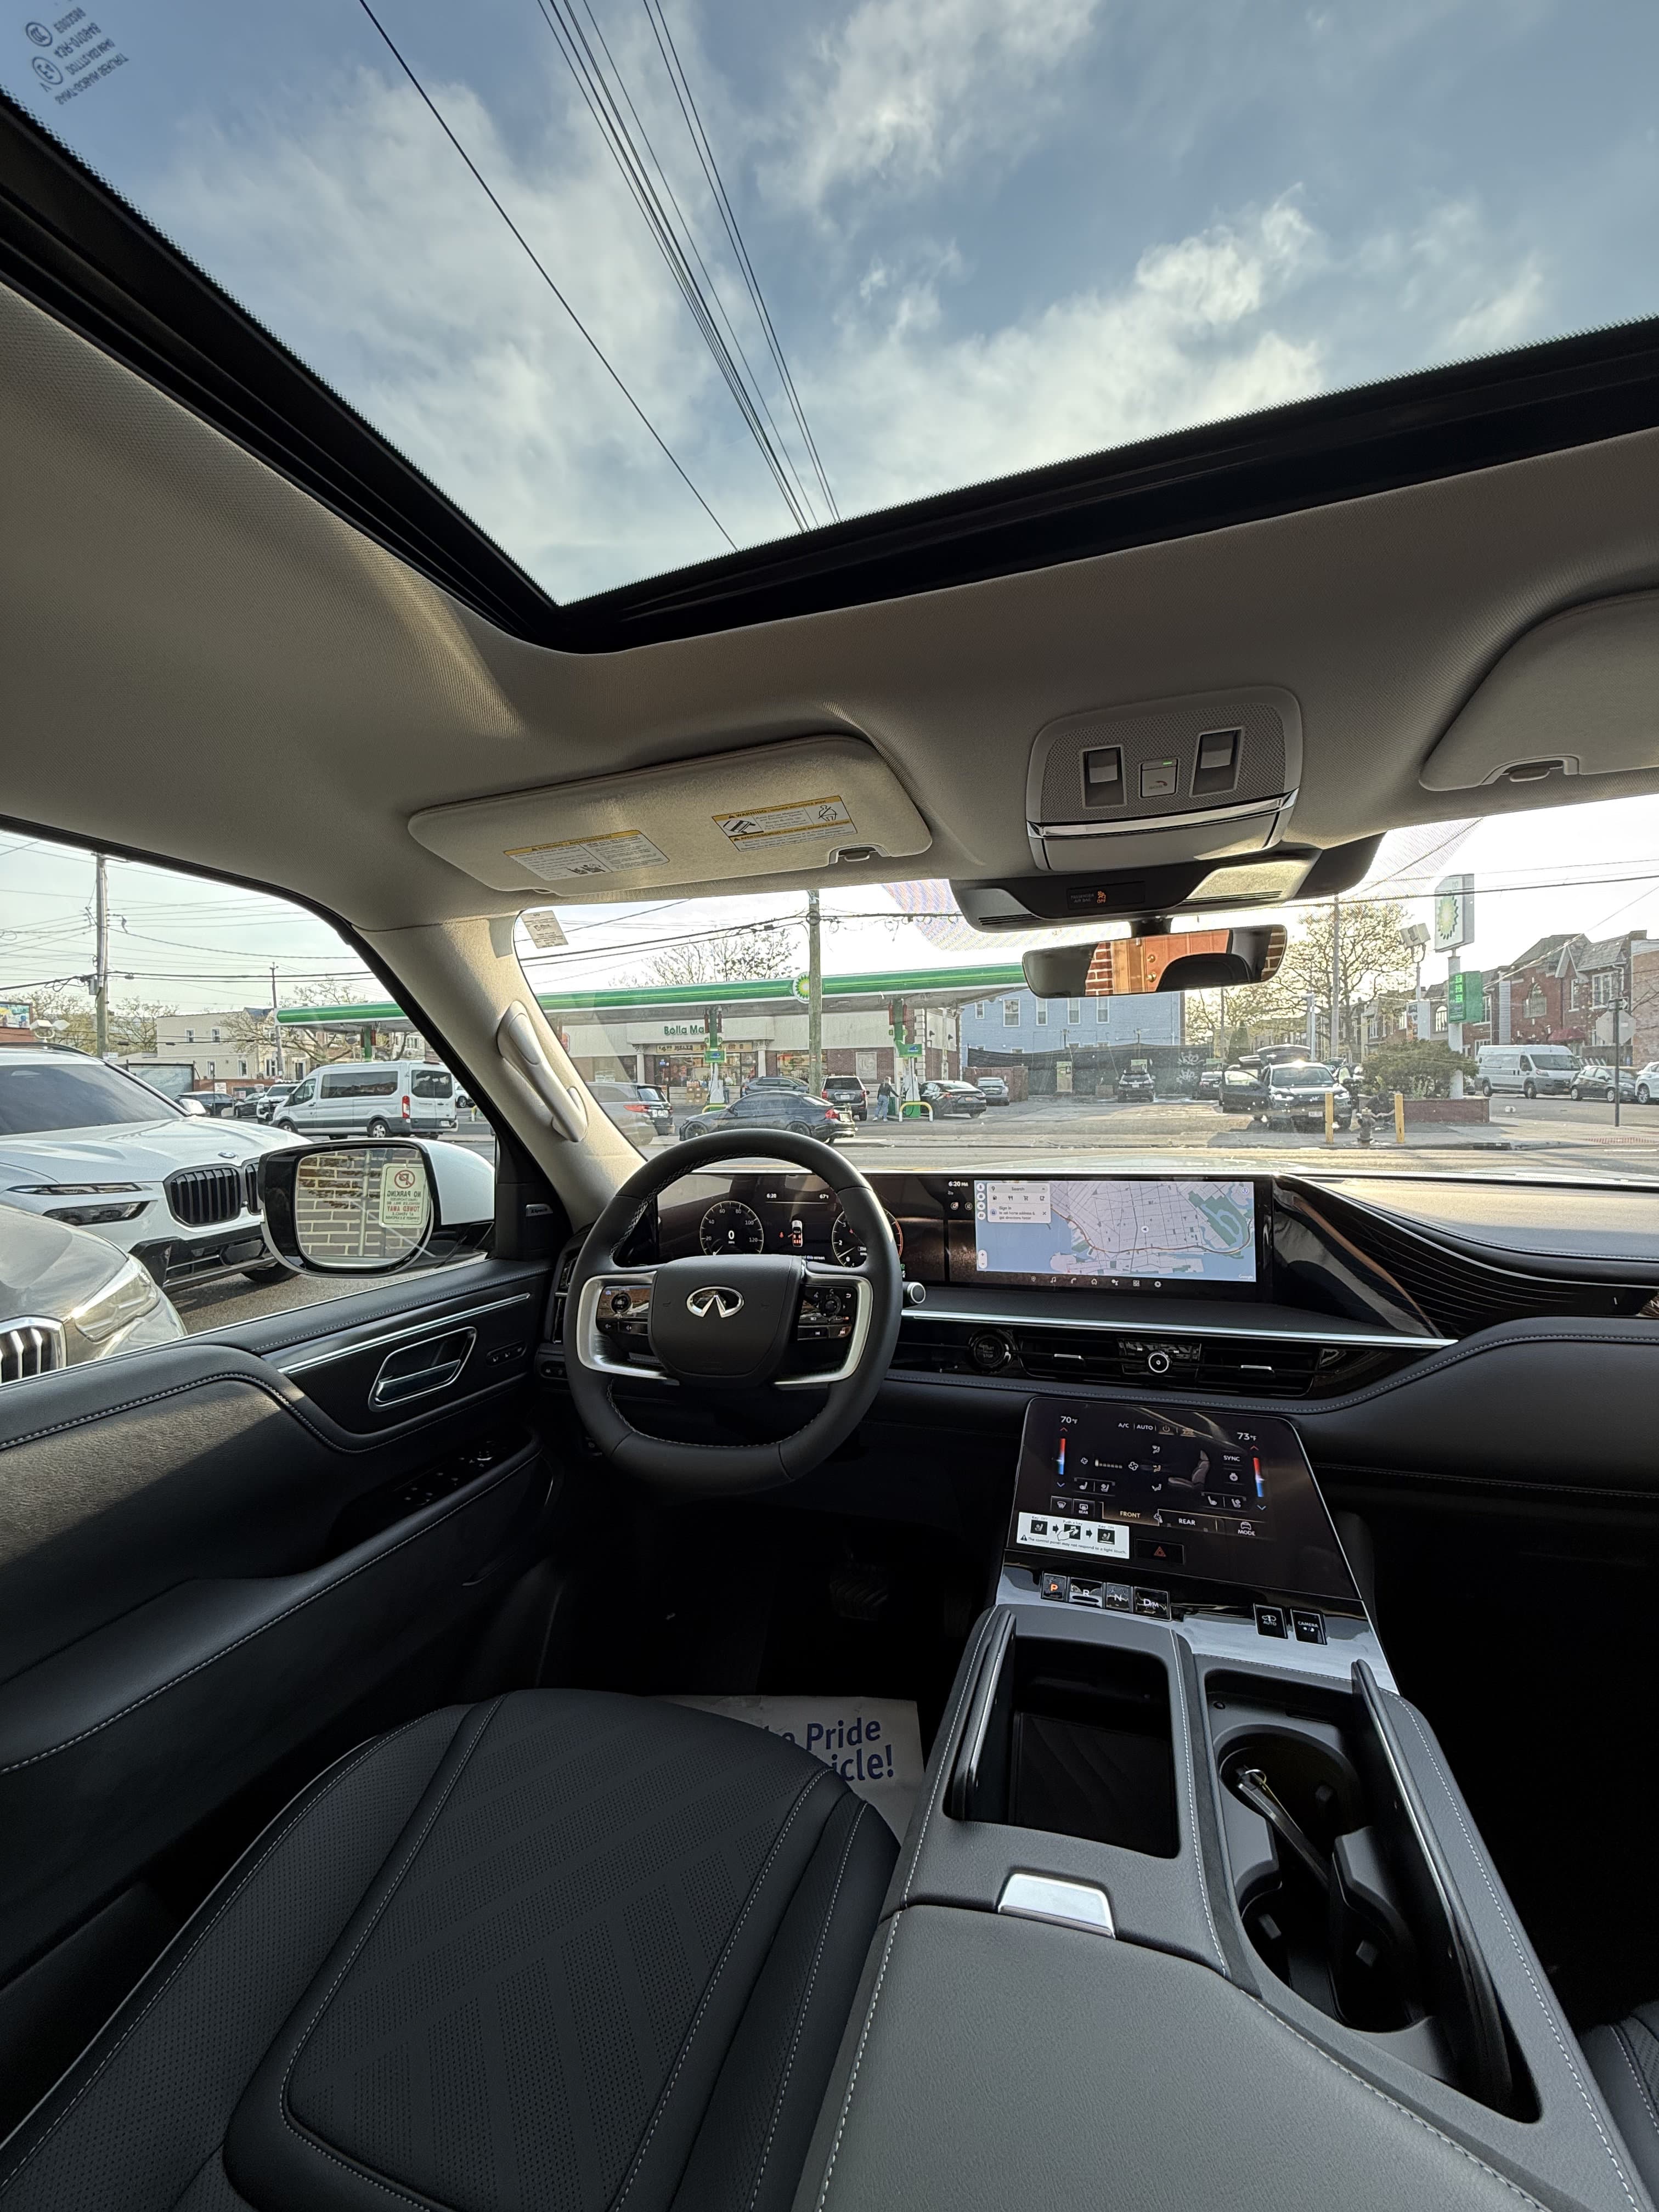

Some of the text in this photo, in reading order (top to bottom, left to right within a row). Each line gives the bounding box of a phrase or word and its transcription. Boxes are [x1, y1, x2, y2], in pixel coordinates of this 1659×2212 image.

[664, 1025, 687, 1035] Bolla
[728, 1230, 735, 1240] 0
[1237, 1432, 1257, 1441] 73°F
[1050, 1583, 1058, 1592] P
[1082, 1589, 1090, 1597] R
[1114, 1593, 1122, 1602] N
[806, 1717, 881, 1751] Pride
